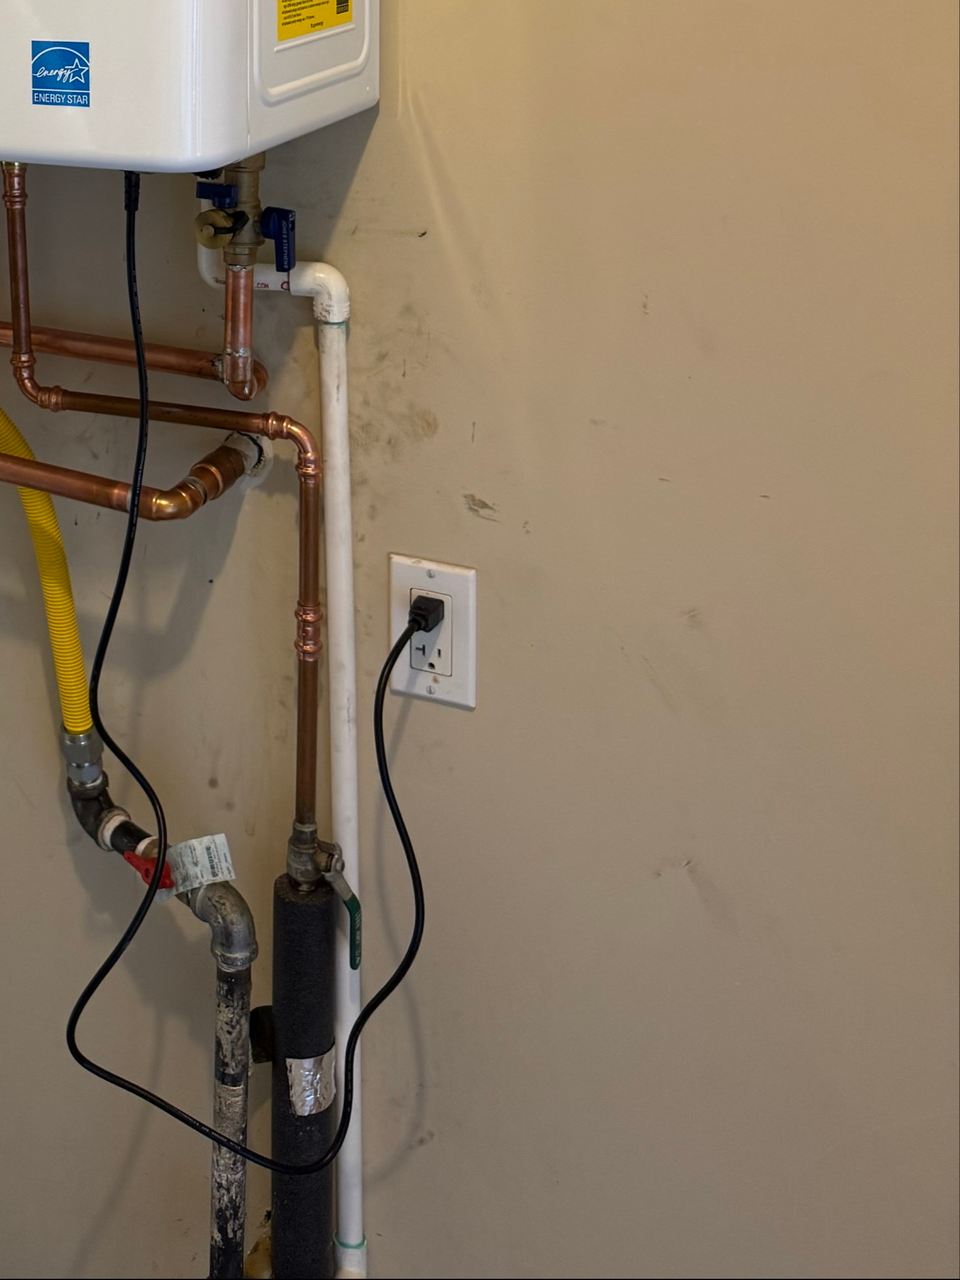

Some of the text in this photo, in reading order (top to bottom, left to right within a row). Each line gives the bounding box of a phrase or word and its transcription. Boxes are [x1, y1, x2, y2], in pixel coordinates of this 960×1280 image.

[36, 66, 72, 83] energy
[34, 92, 89, 105] ENERGY STAR
